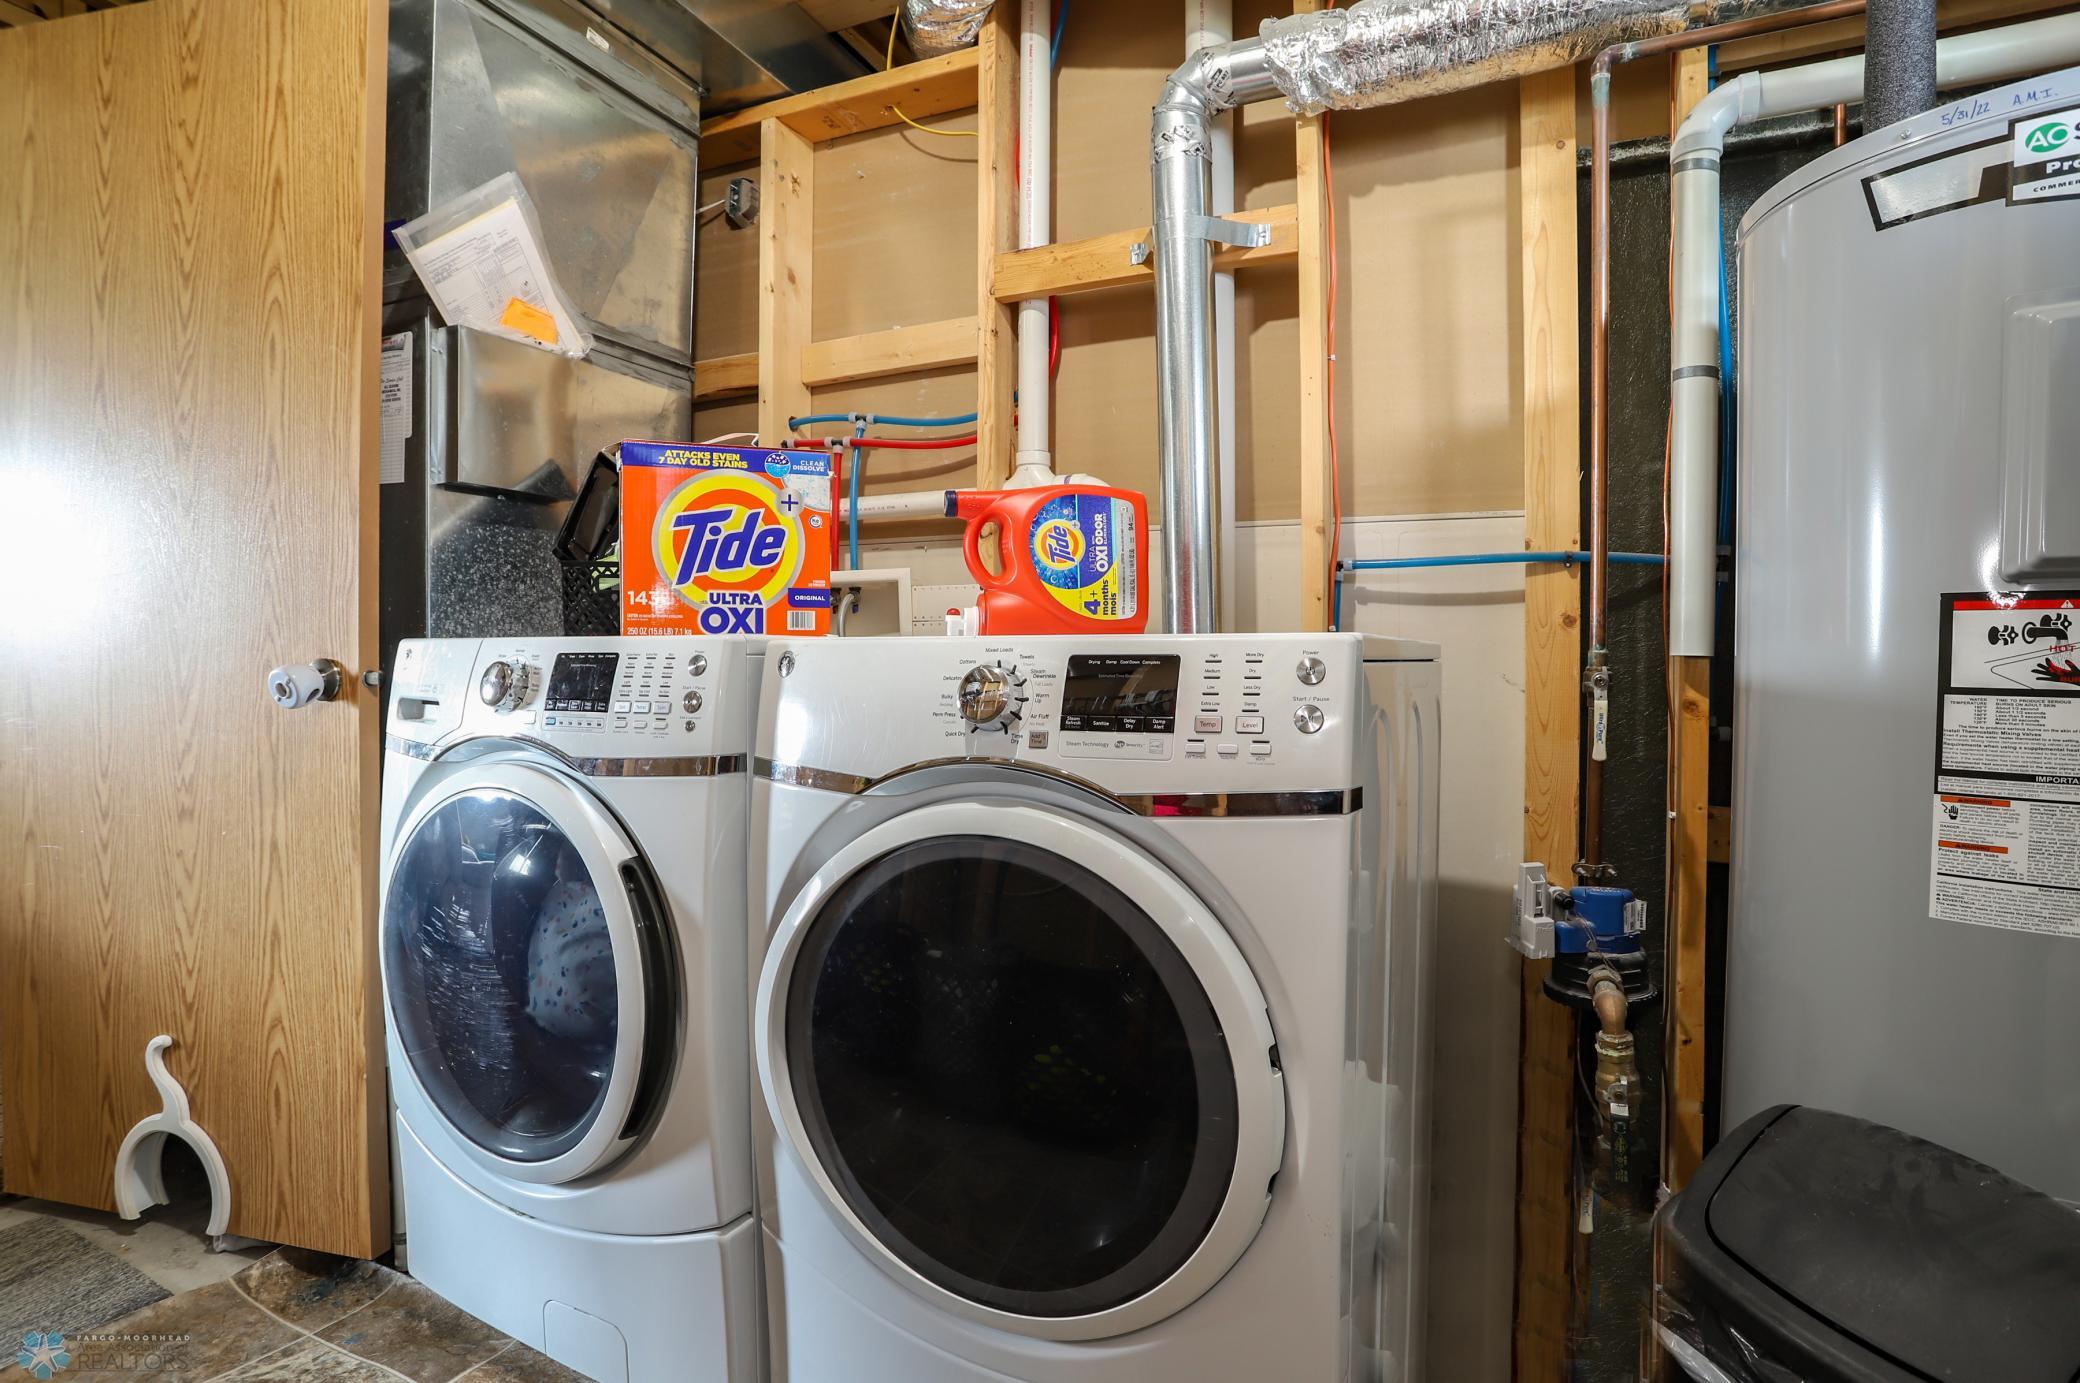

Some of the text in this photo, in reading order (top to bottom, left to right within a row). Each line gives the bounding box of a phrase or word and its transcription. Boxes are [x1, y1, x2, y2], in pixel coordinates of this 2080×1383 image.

[1941, 100, 1990, 126] 5/31/22
[658, 456, 748, 468] 7 DAY OLD STAINS
[664, 450, 740, 461] ATTACKS EVEN
[1095, 513, 1103, 545] ODOR
[672, 508, 787, 587] Tide
[1048, 525, 1076, 563] Tide
[1096, 545, 1109, 572] OXI
[709, 592, 763, 605] ULTRA
[1101, 579, 1109, 615] months
[700, 606, 764, 634] OXI
